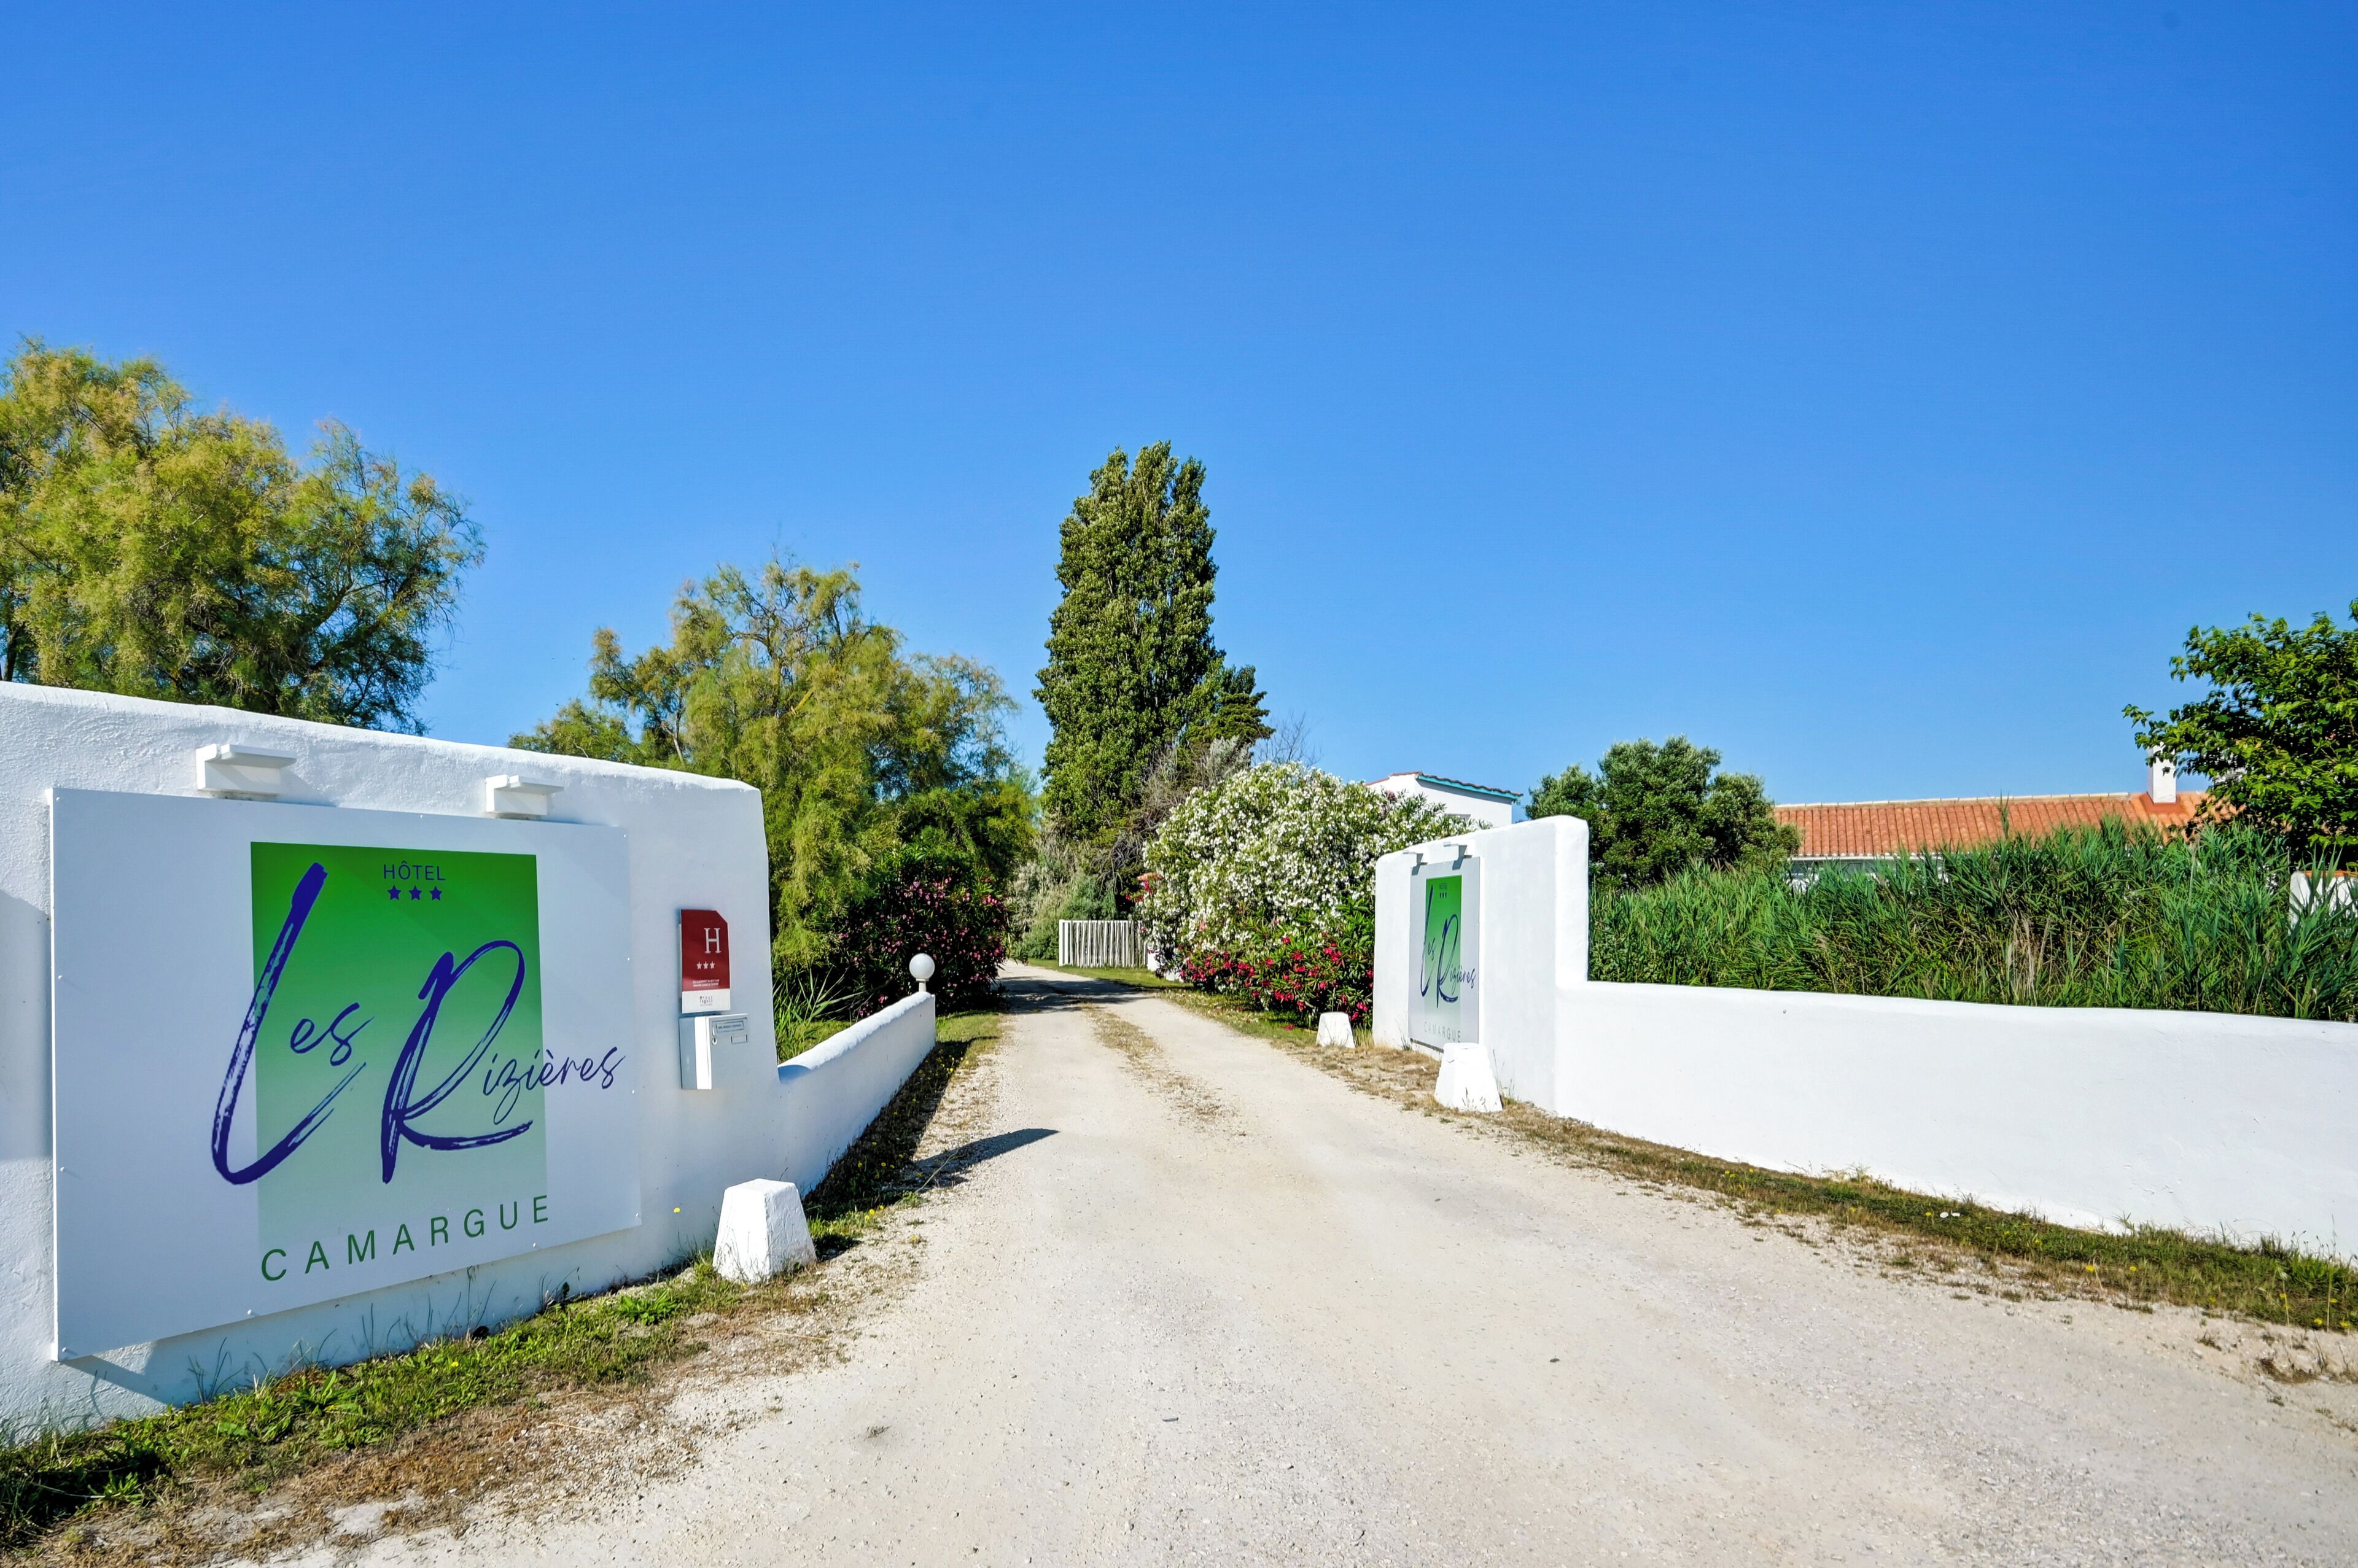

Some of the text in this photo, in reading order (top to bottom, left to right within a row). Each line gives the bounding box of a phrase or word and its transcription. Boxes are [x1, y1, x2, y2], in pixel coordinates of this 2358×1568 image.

[383, 860, 446, 880] HÔTEL
[704, 928, 722, 953] H
[1420, 884, 1476, 1008] Les Rizières
[211, 862, 626, 1185] Les Rizières
[1424, 1021, 1461, 1043] CAMARGUE
[261, 1195, 549, 1281] CAMARGUE
